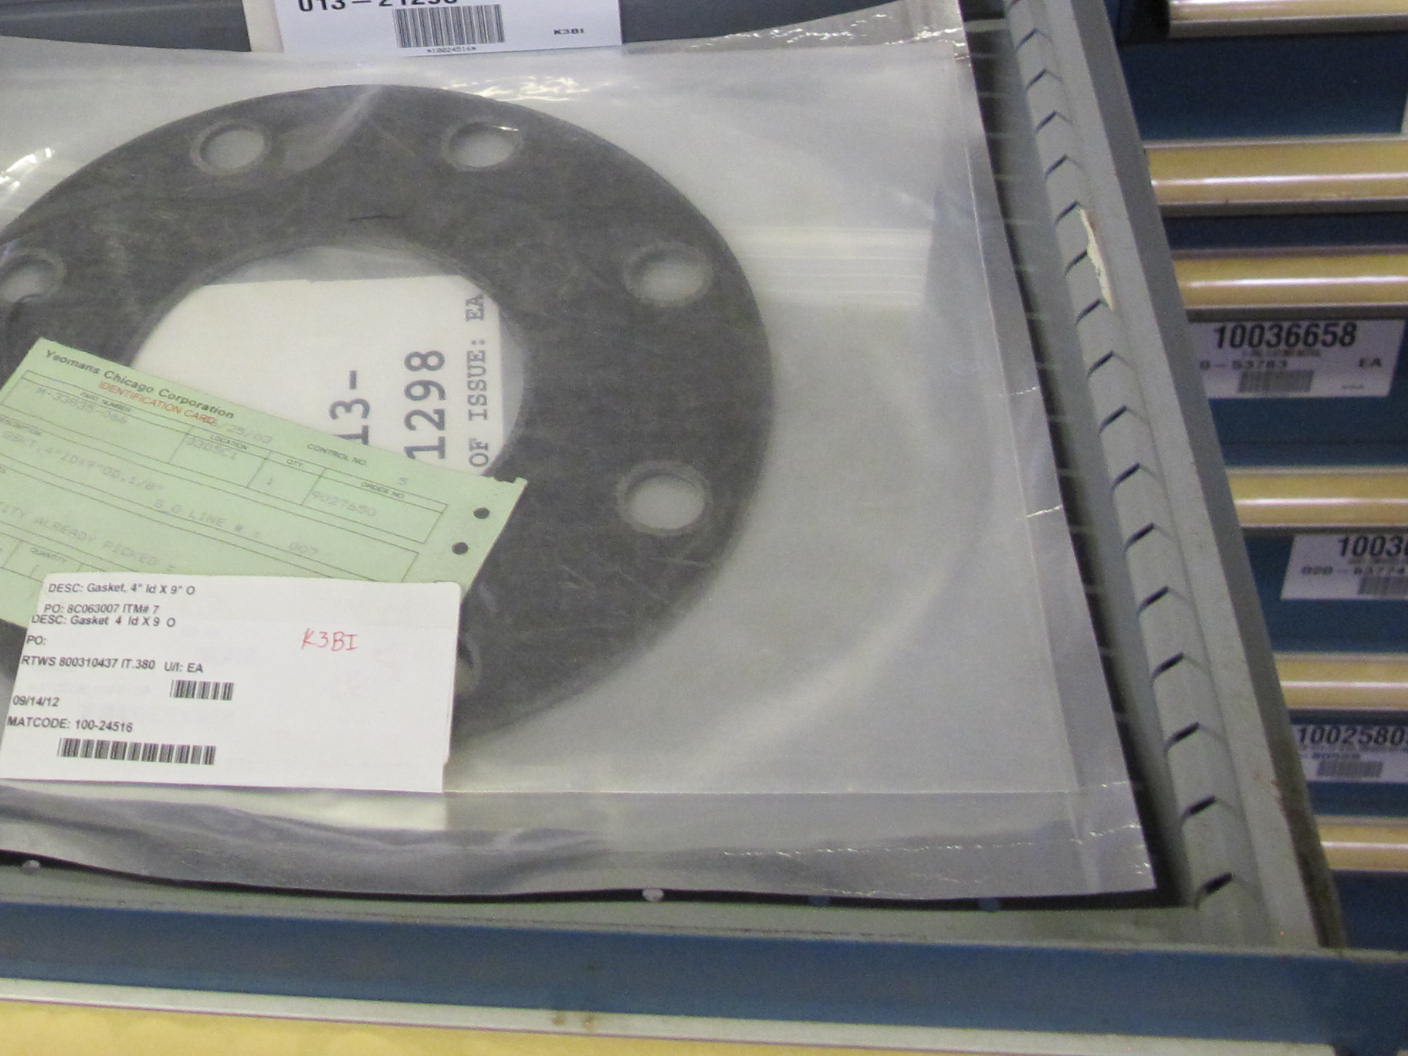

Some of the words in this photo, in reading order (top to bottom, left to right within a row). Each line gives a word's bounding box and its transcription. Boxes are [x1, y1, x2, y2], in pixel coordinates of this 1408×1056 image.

[1214, 322, 1357, 348] 10036658
[1359, 358, 1382, 368] EA
[45, 349, 100, 374] Yeomans
[104, 370, 154, 394] Chicago
[158, 388, 235, 419] Corporation
[467, 339, 488, 421] ISSUE:
[99, 380, 182, 415] IDENTIFICATION
[183, 408, 217, 425] CARD
[307, 443, 349, 462] CONTROL
[468, 438, 489, 468] OF
[48, 583, 83, 593] DESC:
[146, 584, 156, 593] Id
[160, 585, 167, 593] X
[186, 586, 196, 595] O
[44, 604, 64, 613] PO:
[153, 605, 160, 614] 7
[32, 615, 67, 624] DESC:
[70, 615, 109, 625] Gasket
[115, 616, 121, 625] 4
[128, 616, 138, 626] Id
[142, 617, 150, 626] X
[153, 617, 160, 626] 9
[166, 618, 176, 627] O
[26, 635, 47, 645] PO:
[21, 655, 55, 666] RTWS
[186, 662, 204, 673] EA
[12, 694, 59, 707] 09/14/12
[7, 715, 70, 729] MATCODE:
[75, 718, 134, 732] 100-24516
